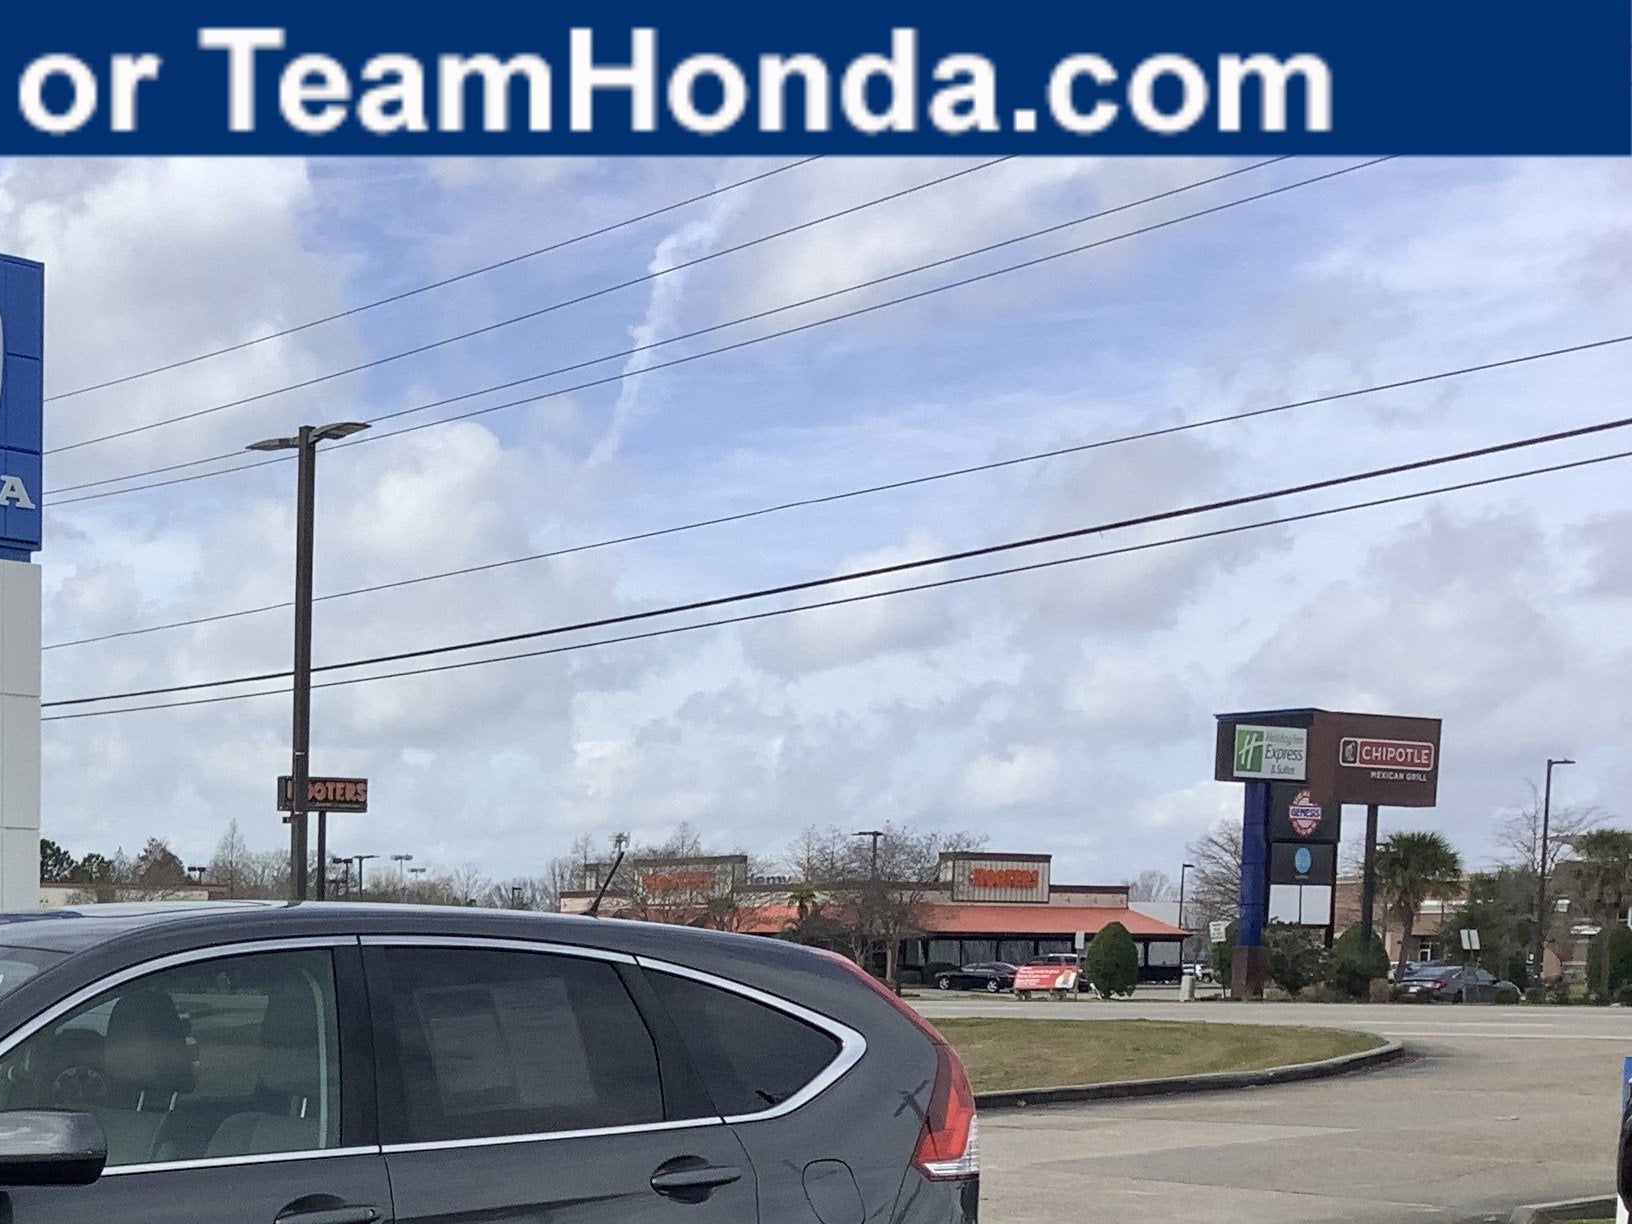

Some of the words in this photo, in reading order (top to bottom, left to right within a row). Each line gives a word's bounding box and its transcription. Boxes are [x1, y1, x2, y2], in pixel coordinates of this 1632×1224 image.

[1265, 745, 1303, 763] Express
[1361, 746, 1430, 764] CHIPOTLE
[1276, 765, 1294, 775] Suites
[1370, 771, 1404, 780] MEXICAN
[1406, 773, 1427, 782] GRILL
[287, 780, 366, 802] OTERS
